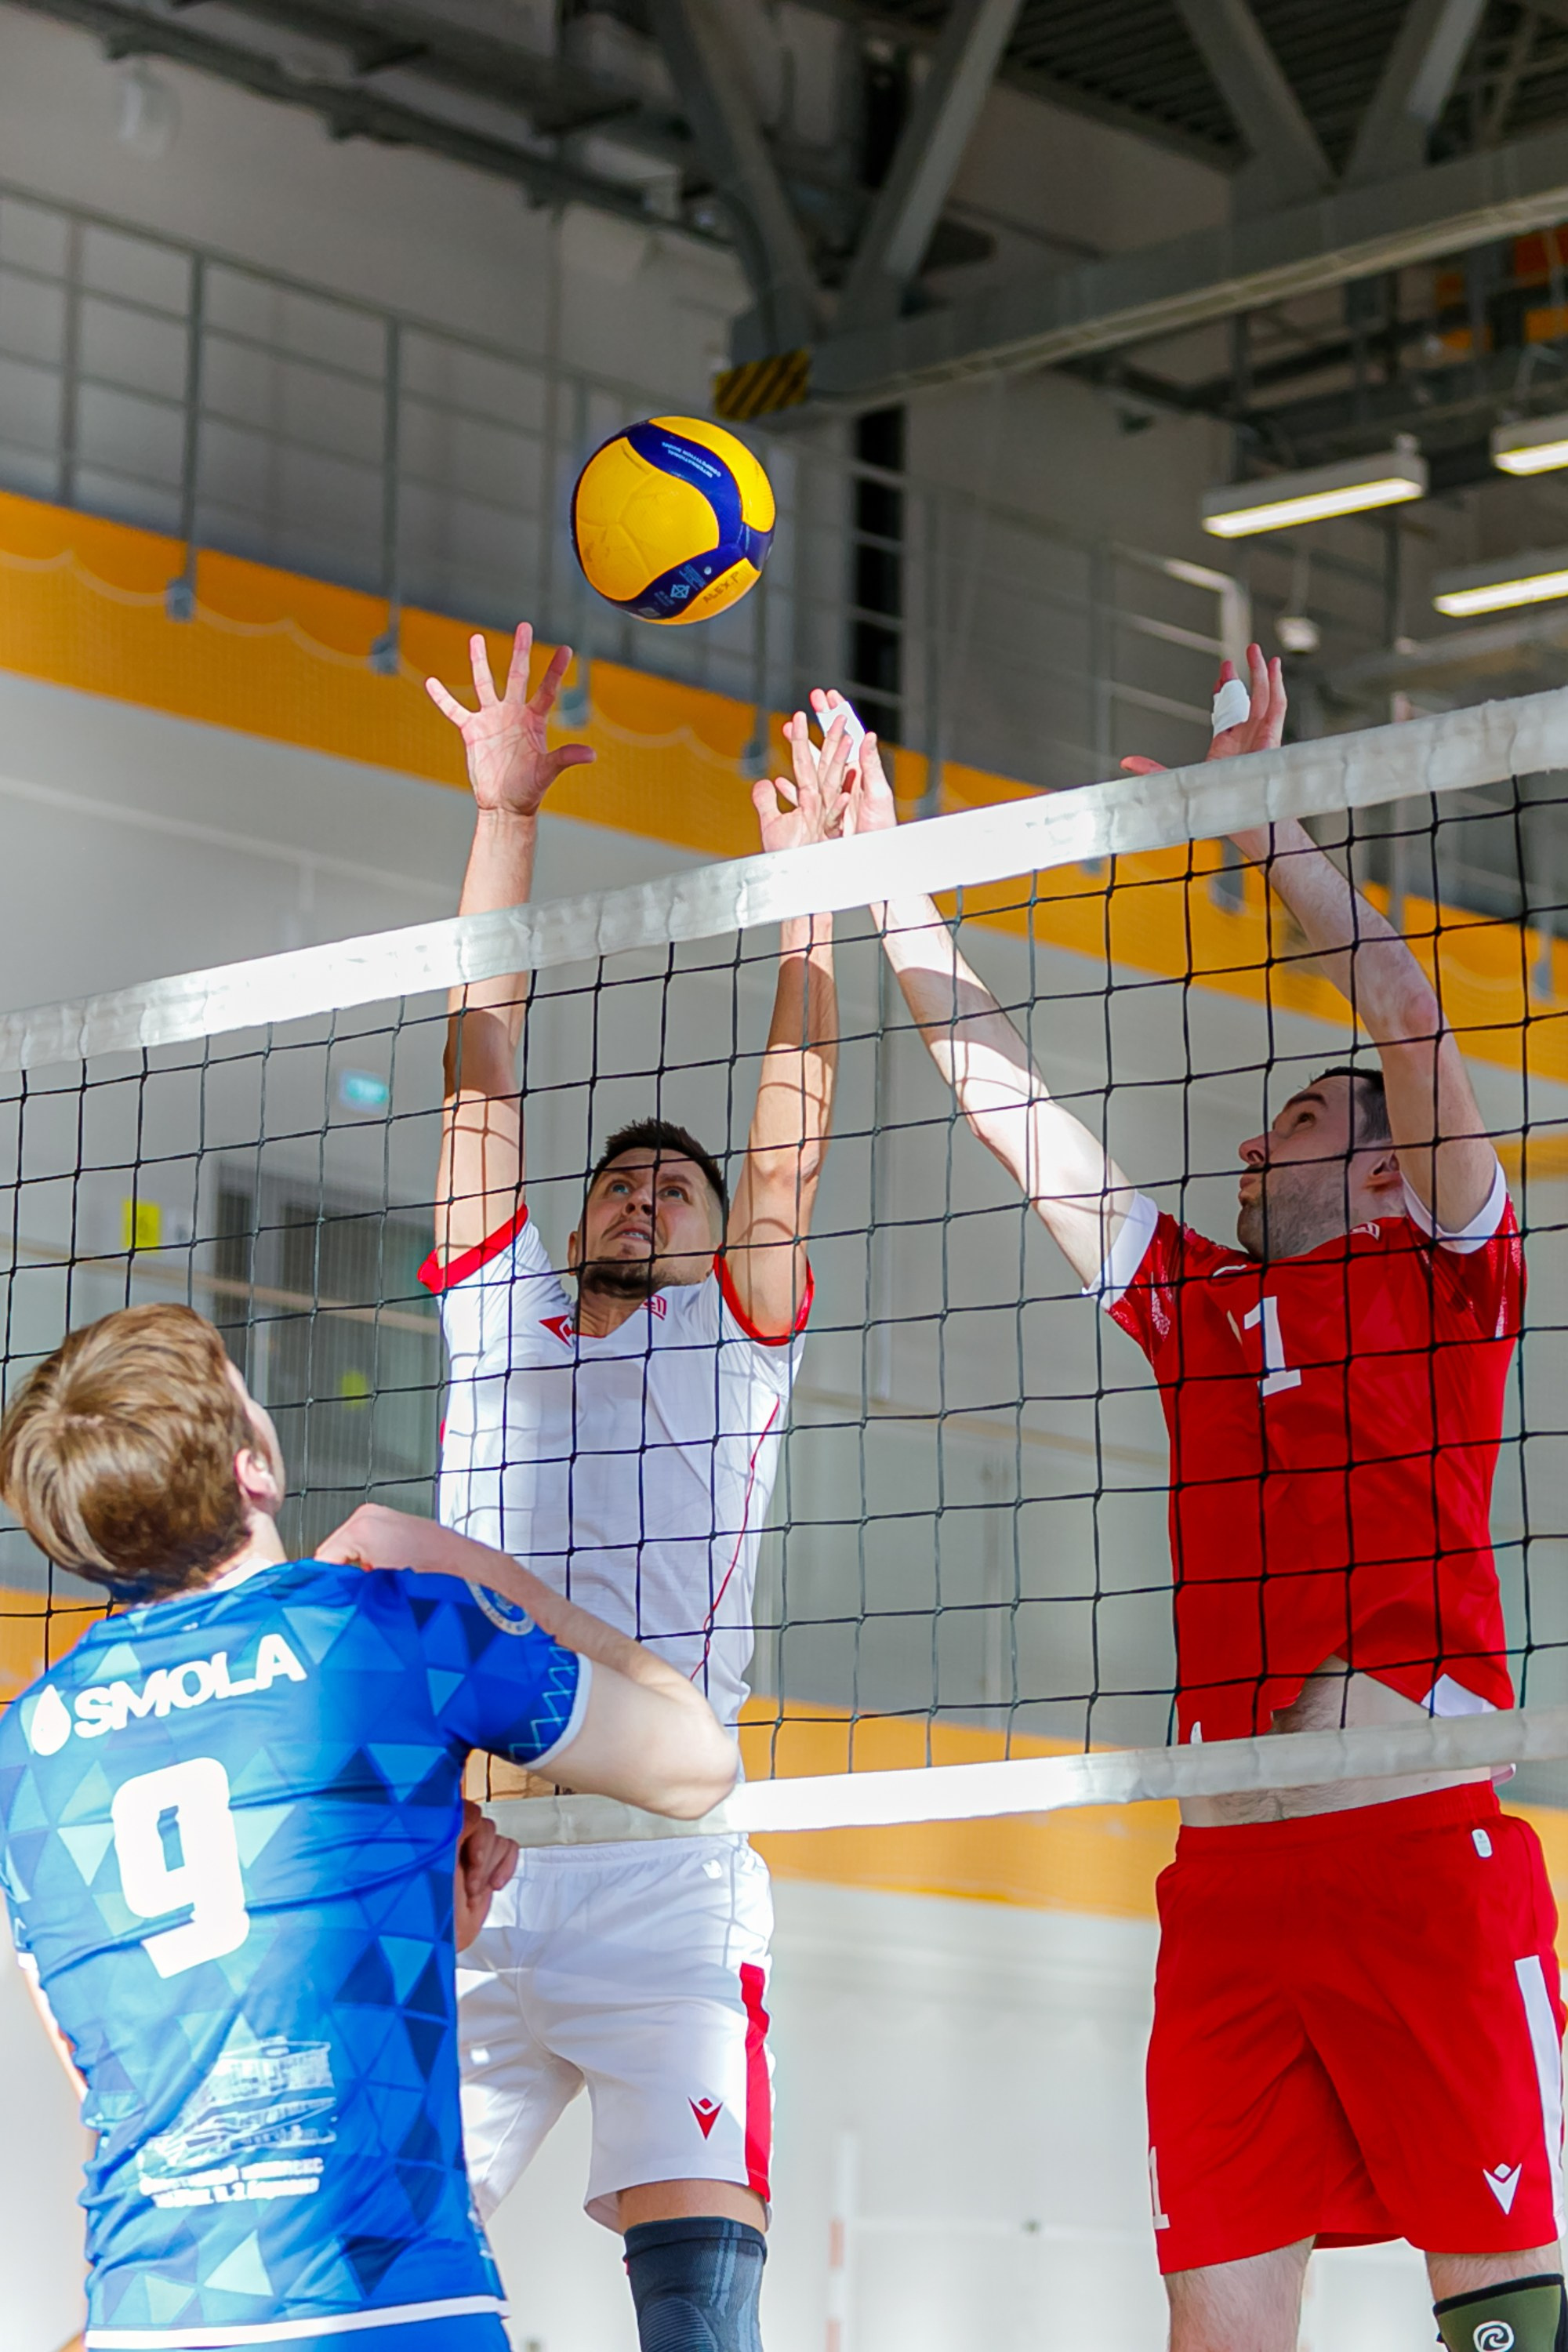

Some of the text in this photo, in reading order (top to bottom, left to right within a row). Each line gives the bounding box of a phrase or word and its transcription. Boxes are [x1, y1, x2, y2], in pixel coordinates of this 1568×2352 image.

[668, 449, 713, 478] INTERNATIONAL
[1243, 1296, 1301, 1397] 1
[74, 1633, 307, 1739] SMOLA
[111, 1756, 250, 1980] 9
[1148, 2146, 1171, 2230] 1
